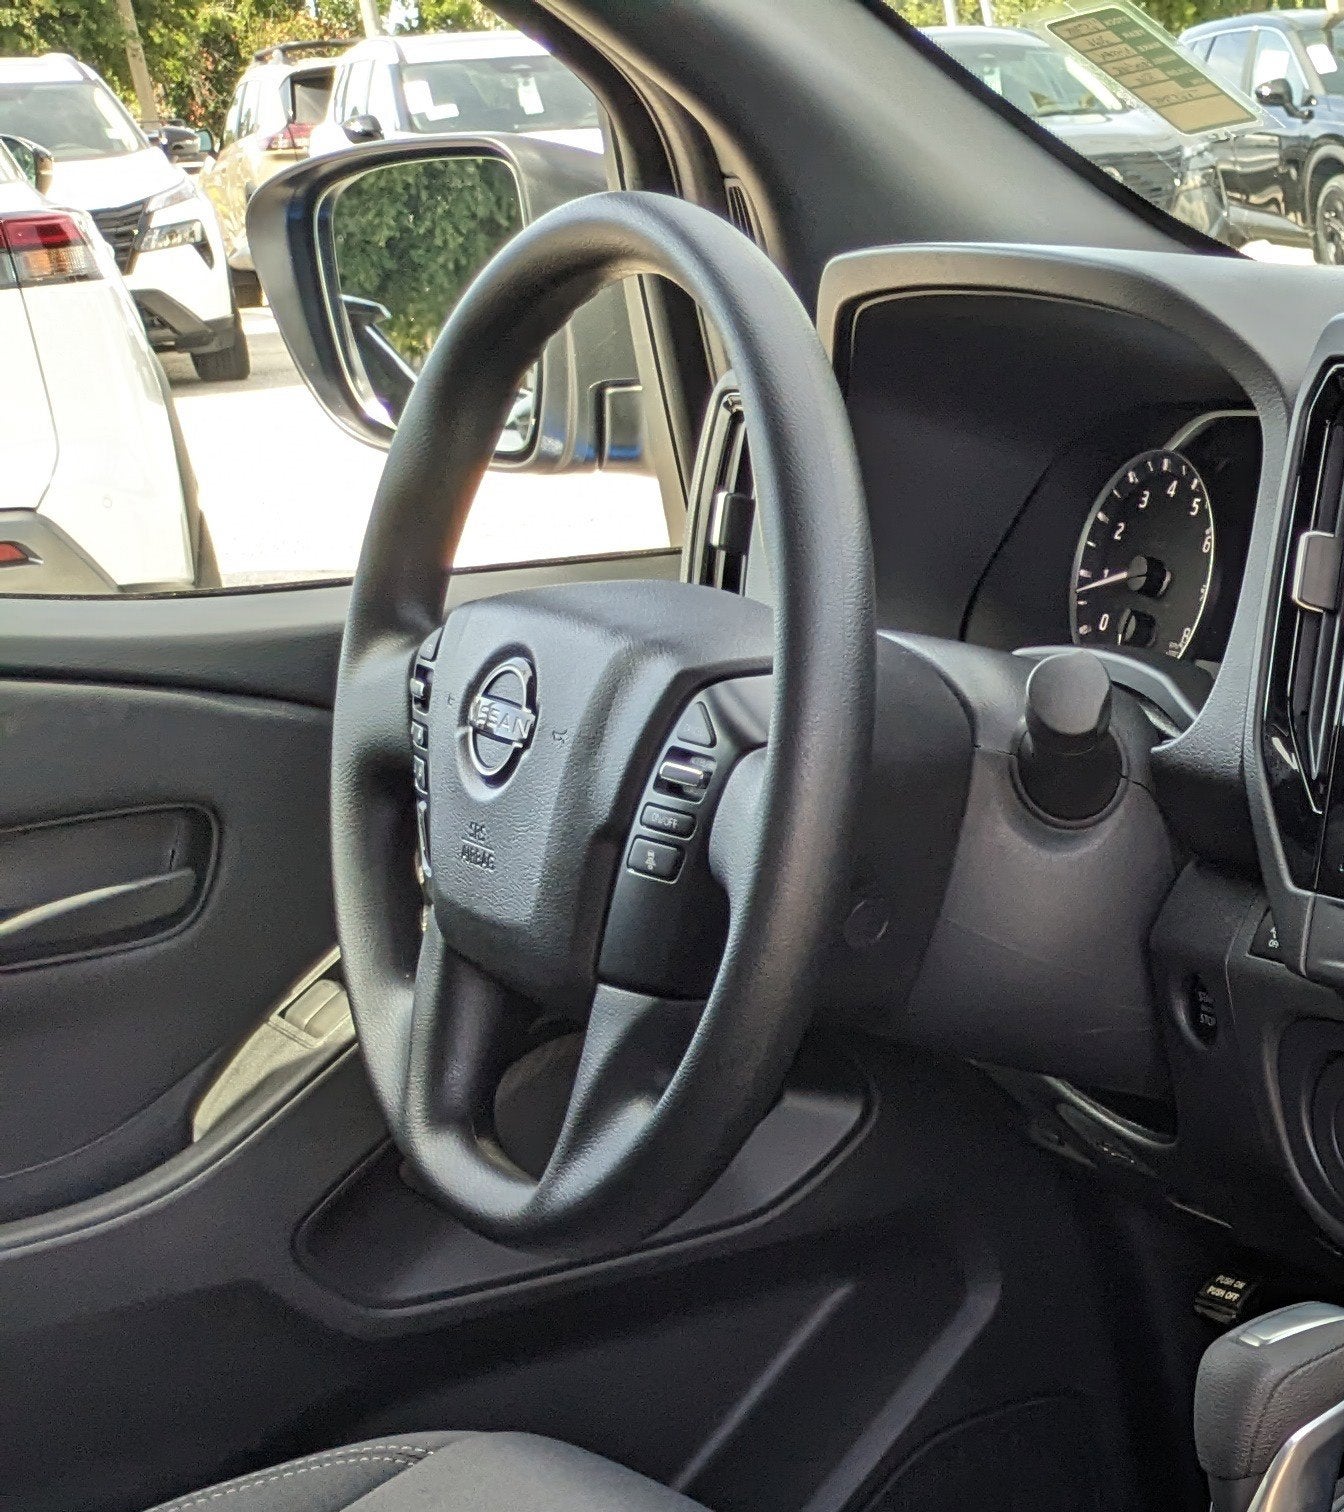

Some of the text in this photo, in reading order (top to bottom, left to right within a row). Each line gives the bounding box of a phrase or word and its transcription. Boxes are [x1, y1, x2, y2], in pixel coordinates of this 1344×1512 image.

[1167, 480, 1178, 497] 4
[1138, 490, 1150, 508] 3
[1189, 498, 1202, 515] 5
[1113, 522, 1125, 540] 2
[1202, 537, 1212, 553] 6
[1099, 613, 1110, 632] 0
